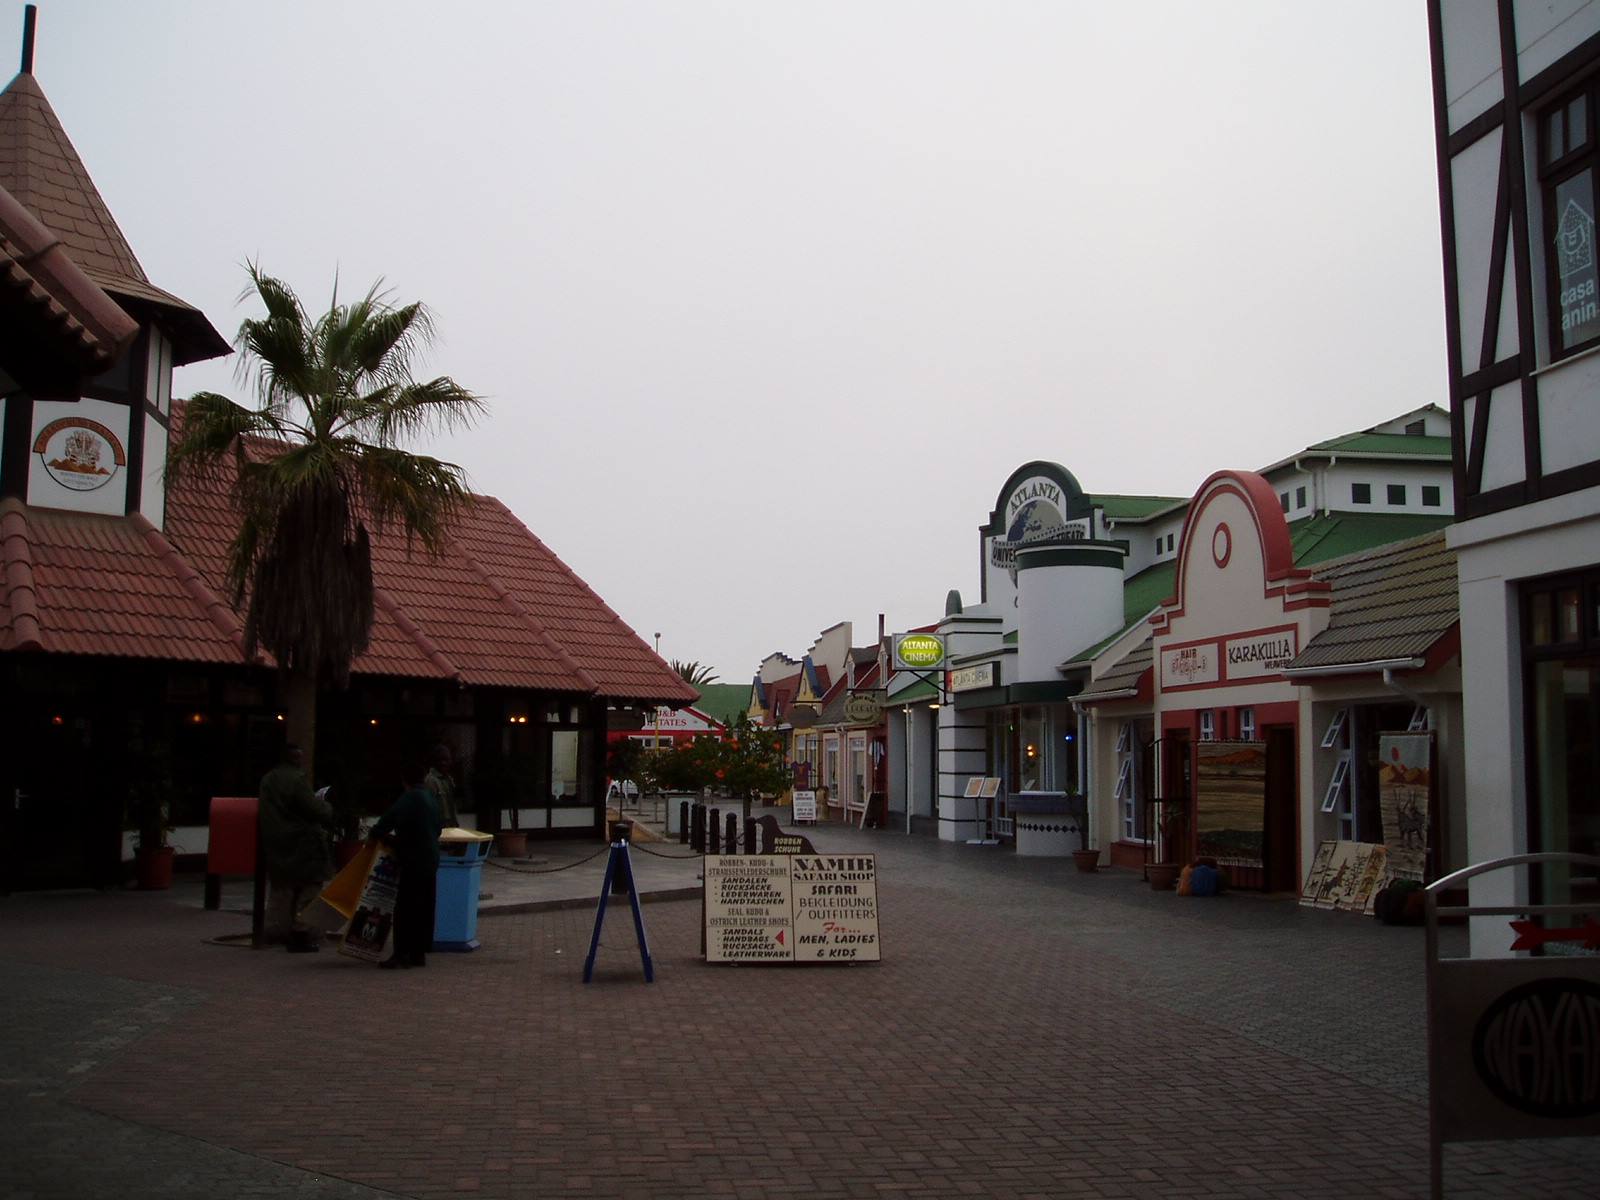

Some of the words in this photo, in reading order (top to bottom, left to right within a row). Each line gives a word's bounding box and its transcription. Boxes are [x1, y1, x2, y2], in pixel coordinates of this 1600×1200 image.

[1560, 279, 1594, 306] casa
[1010, 481, 1061, 514] ATLANTA
[902, 640, 939, 650] ALTANTA
[904, 652, 937, 662] CINEMA
[1180, 648, 1197, 659] HAIR
[774, 836, 803, 846] ROBBEN
[792, 858, 874, 871] NAMIB
[793, 873, 837, 881] SAFARI
[840, 873, 874, 881] SHOP
[811, 885, 858, 895] SAFARI
[799, 897, 873, 908] BEKLEIDUNG
[808, 910, 876, 920] OUTFITTERS
[710, 918, 738, 926] OSTRICH
[739, 918, 767, 926] LEATHER
[768, 918, 790, 927] SHOES
[799, 935, 830, 945] MEN,
[834, 935, 876, 944] LADIES
[816, 949, 825, 958] &
[828, 948, 858, 958] KIDS
